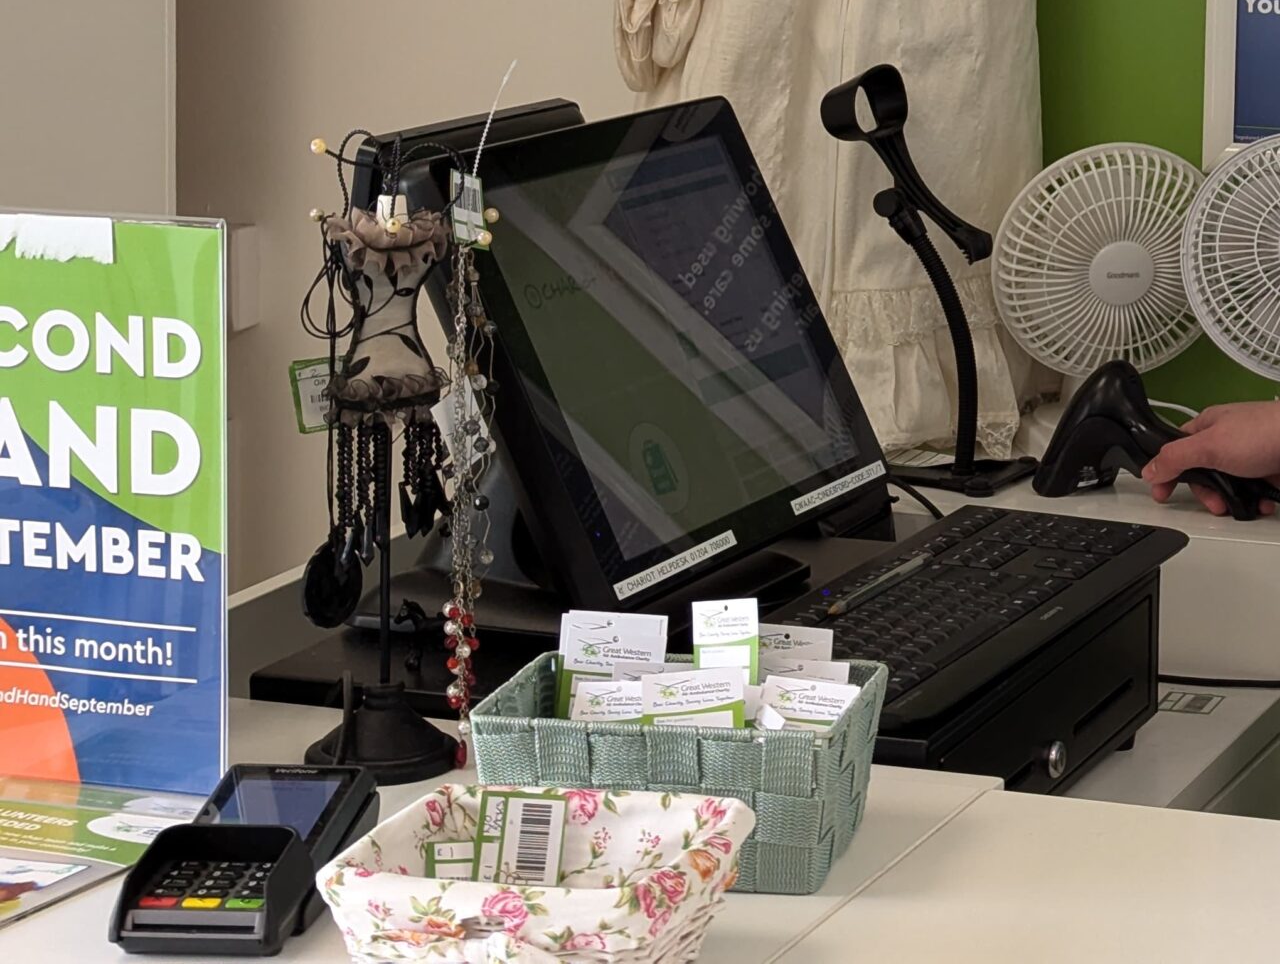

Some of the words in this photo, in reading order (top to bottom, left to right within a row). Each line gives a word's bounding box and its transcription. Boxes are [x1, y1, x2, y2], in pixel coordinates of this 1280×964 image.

[627, 571, 657, 593] CHARIOT
[657, 556, 690, 578] HELPDESK
[16, 626, 66, 655] this
[74, 637, 173, 666] month!
[602, 646, 622, 654] Great
[623, 648, 652, 657] Western
[681, 684, 701, 692] Great
[702, 682, 731, 690] Western
[0, 807, 78, 828] UNTEERS
